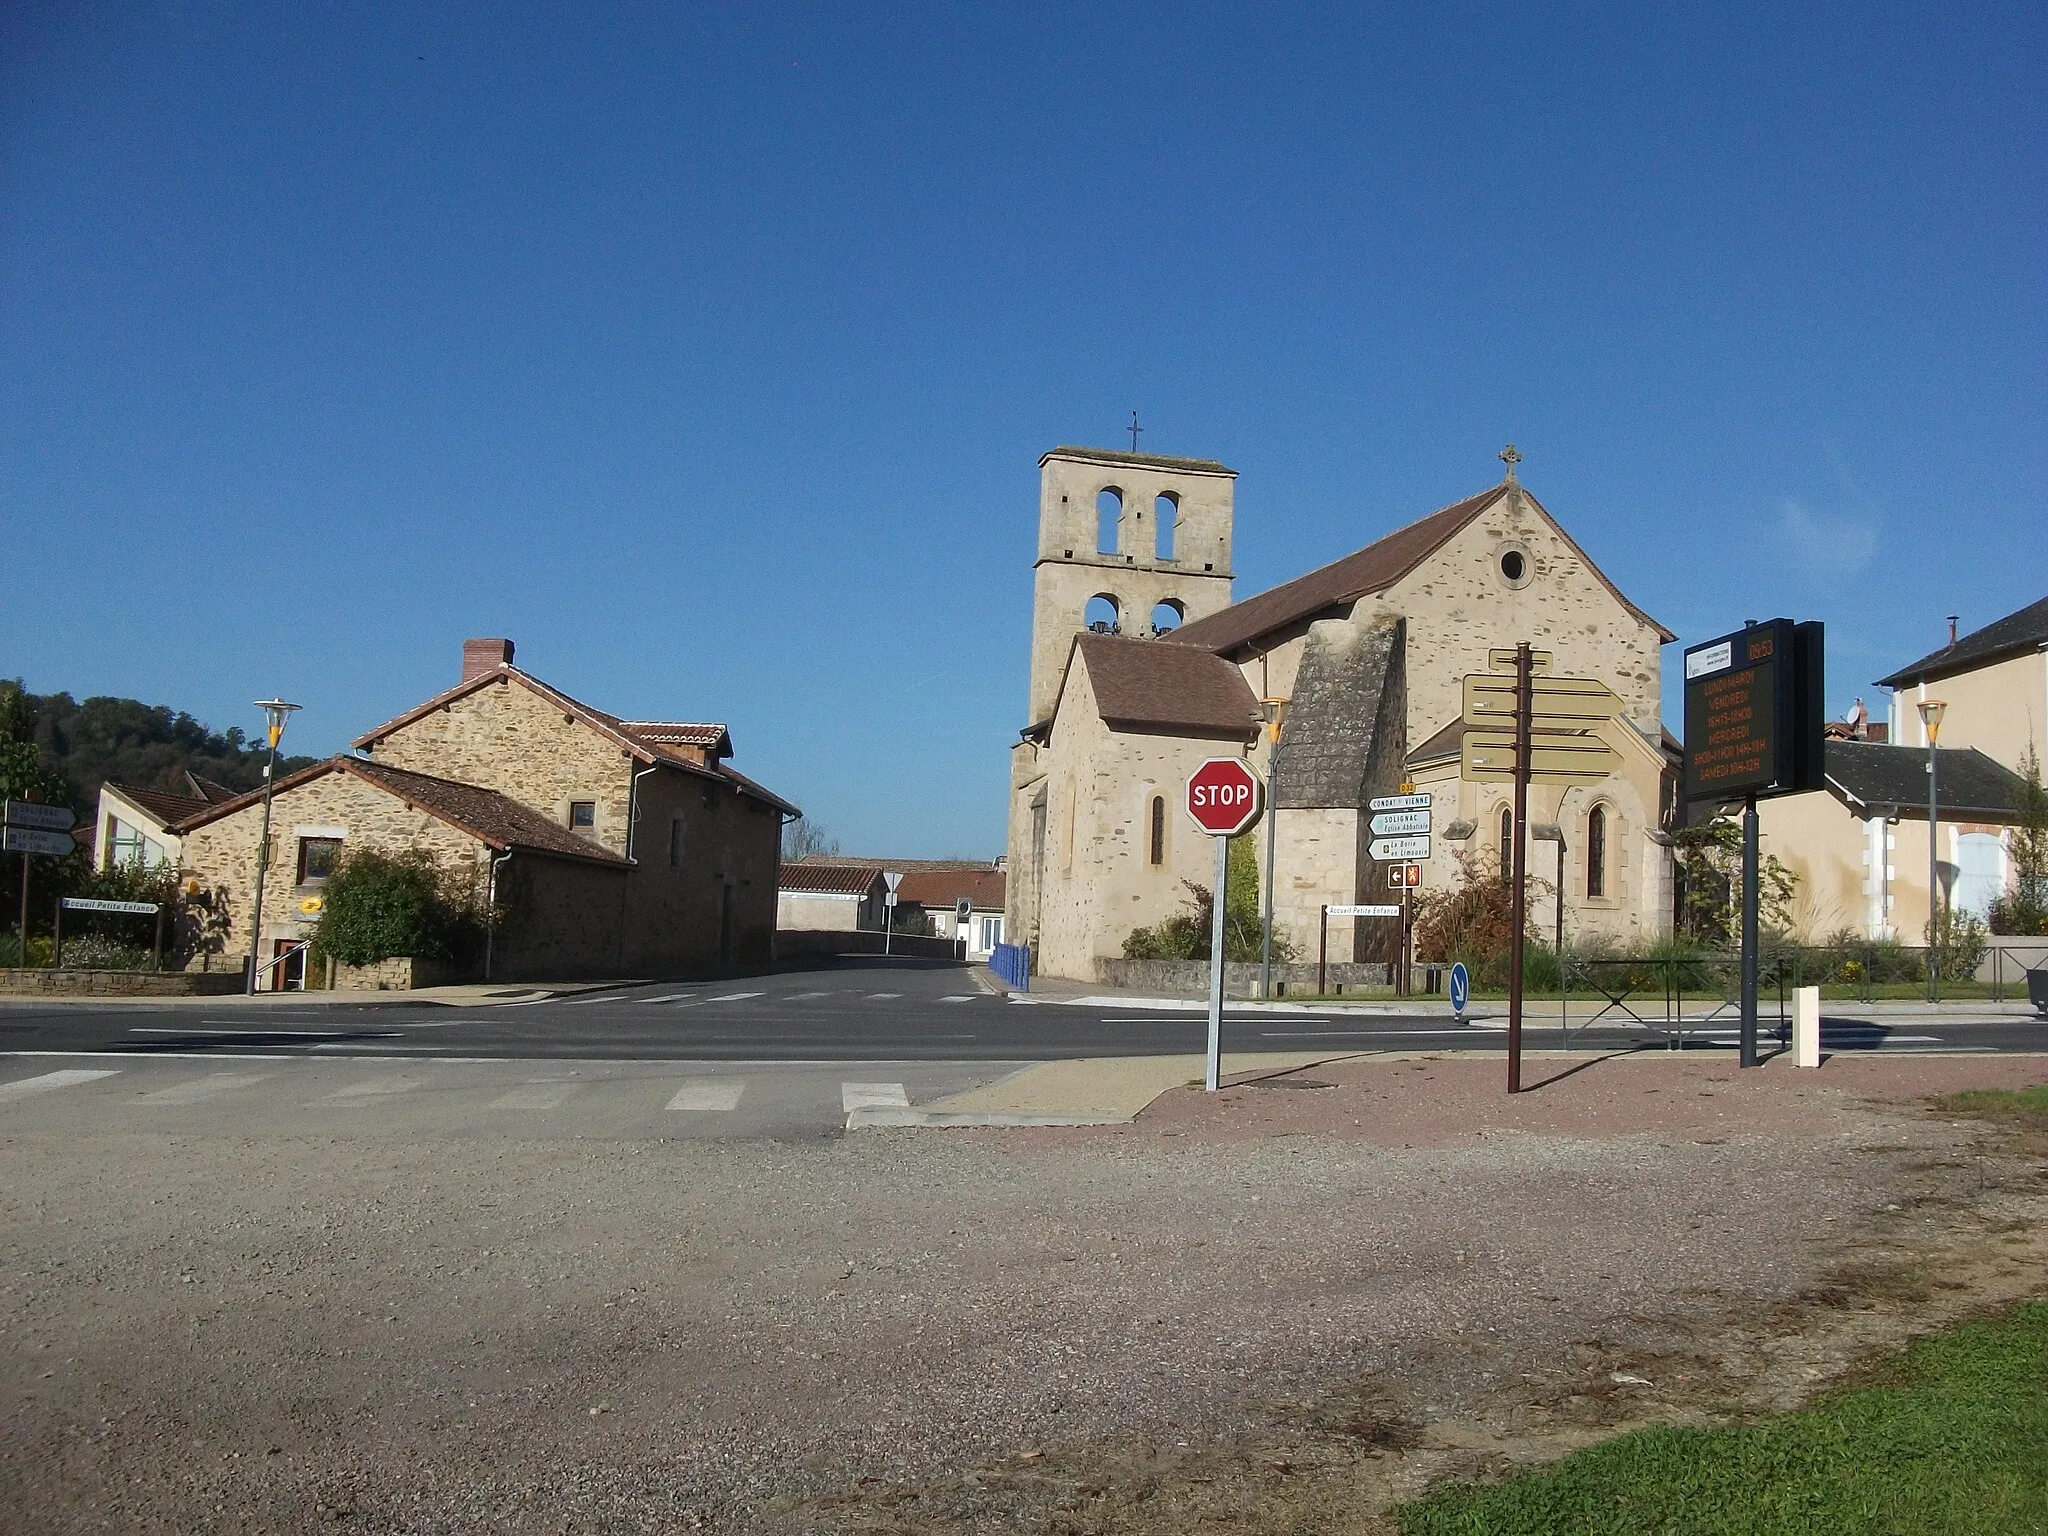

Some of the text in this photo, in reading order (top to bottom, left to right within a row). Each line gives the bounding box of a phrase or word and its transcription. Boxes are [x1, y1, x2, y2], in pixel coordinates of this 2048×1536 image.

[1709, 690, 1749, 710] VENDREDI
[1708, 724, 1750, 745] MERCREDI
[1193, 784, 1249, 806] STOP
[1373, 799, 1396, 808] CONDAT
[1404, 796, 1428, 805] VIENNE
[1384, 814, 1418, 824] SOLIGNAC
[1400, 849, 1428, 857] Limousin
[64, 899, 155, 912] Accueil Petite Enfance
[1352, 906, 1371, 914] Petite
[1373, 906, 1398, 915] Enfance
